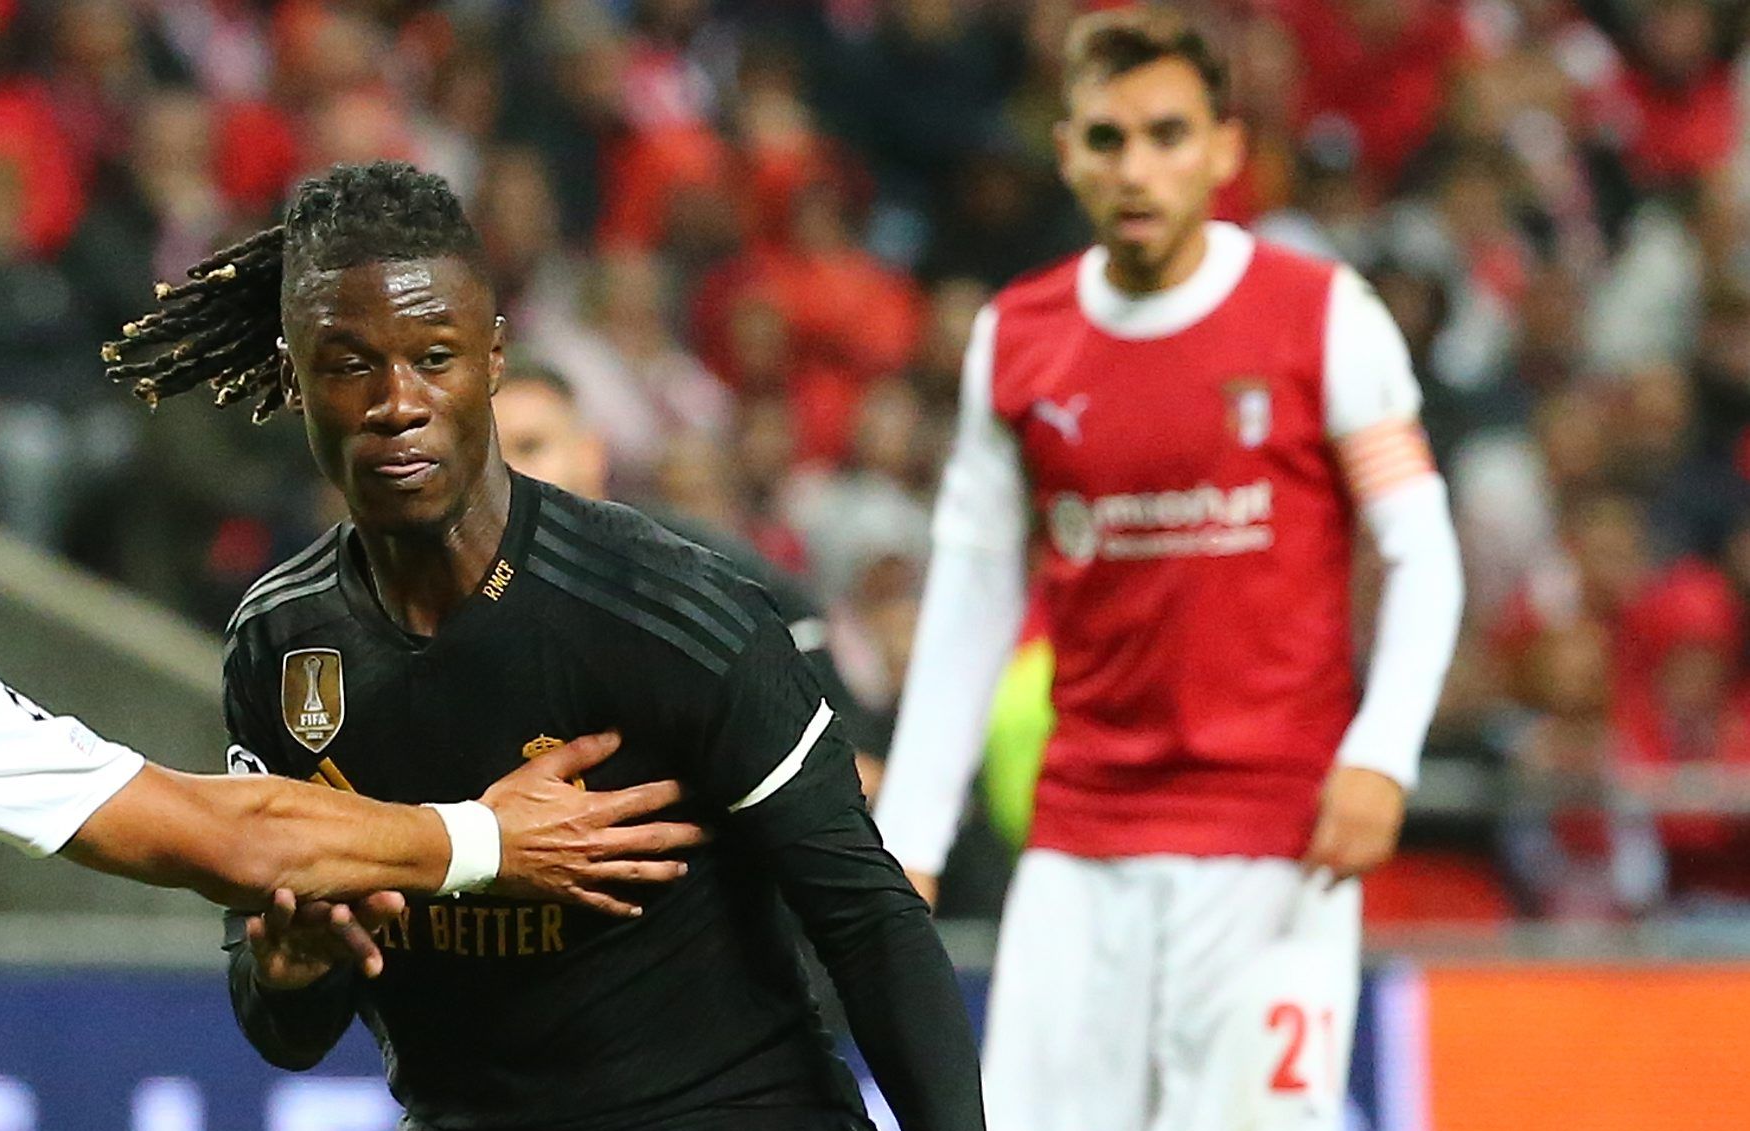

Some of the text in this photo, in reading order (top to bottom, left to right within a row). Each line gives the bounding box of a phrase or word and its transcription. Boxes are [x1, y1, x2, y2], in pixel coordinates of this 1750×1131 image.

[482, 559, 514, 601] RMCF
[300, 712, 329, 726] FIFA
[428, 903, 566, 958] BETTER
